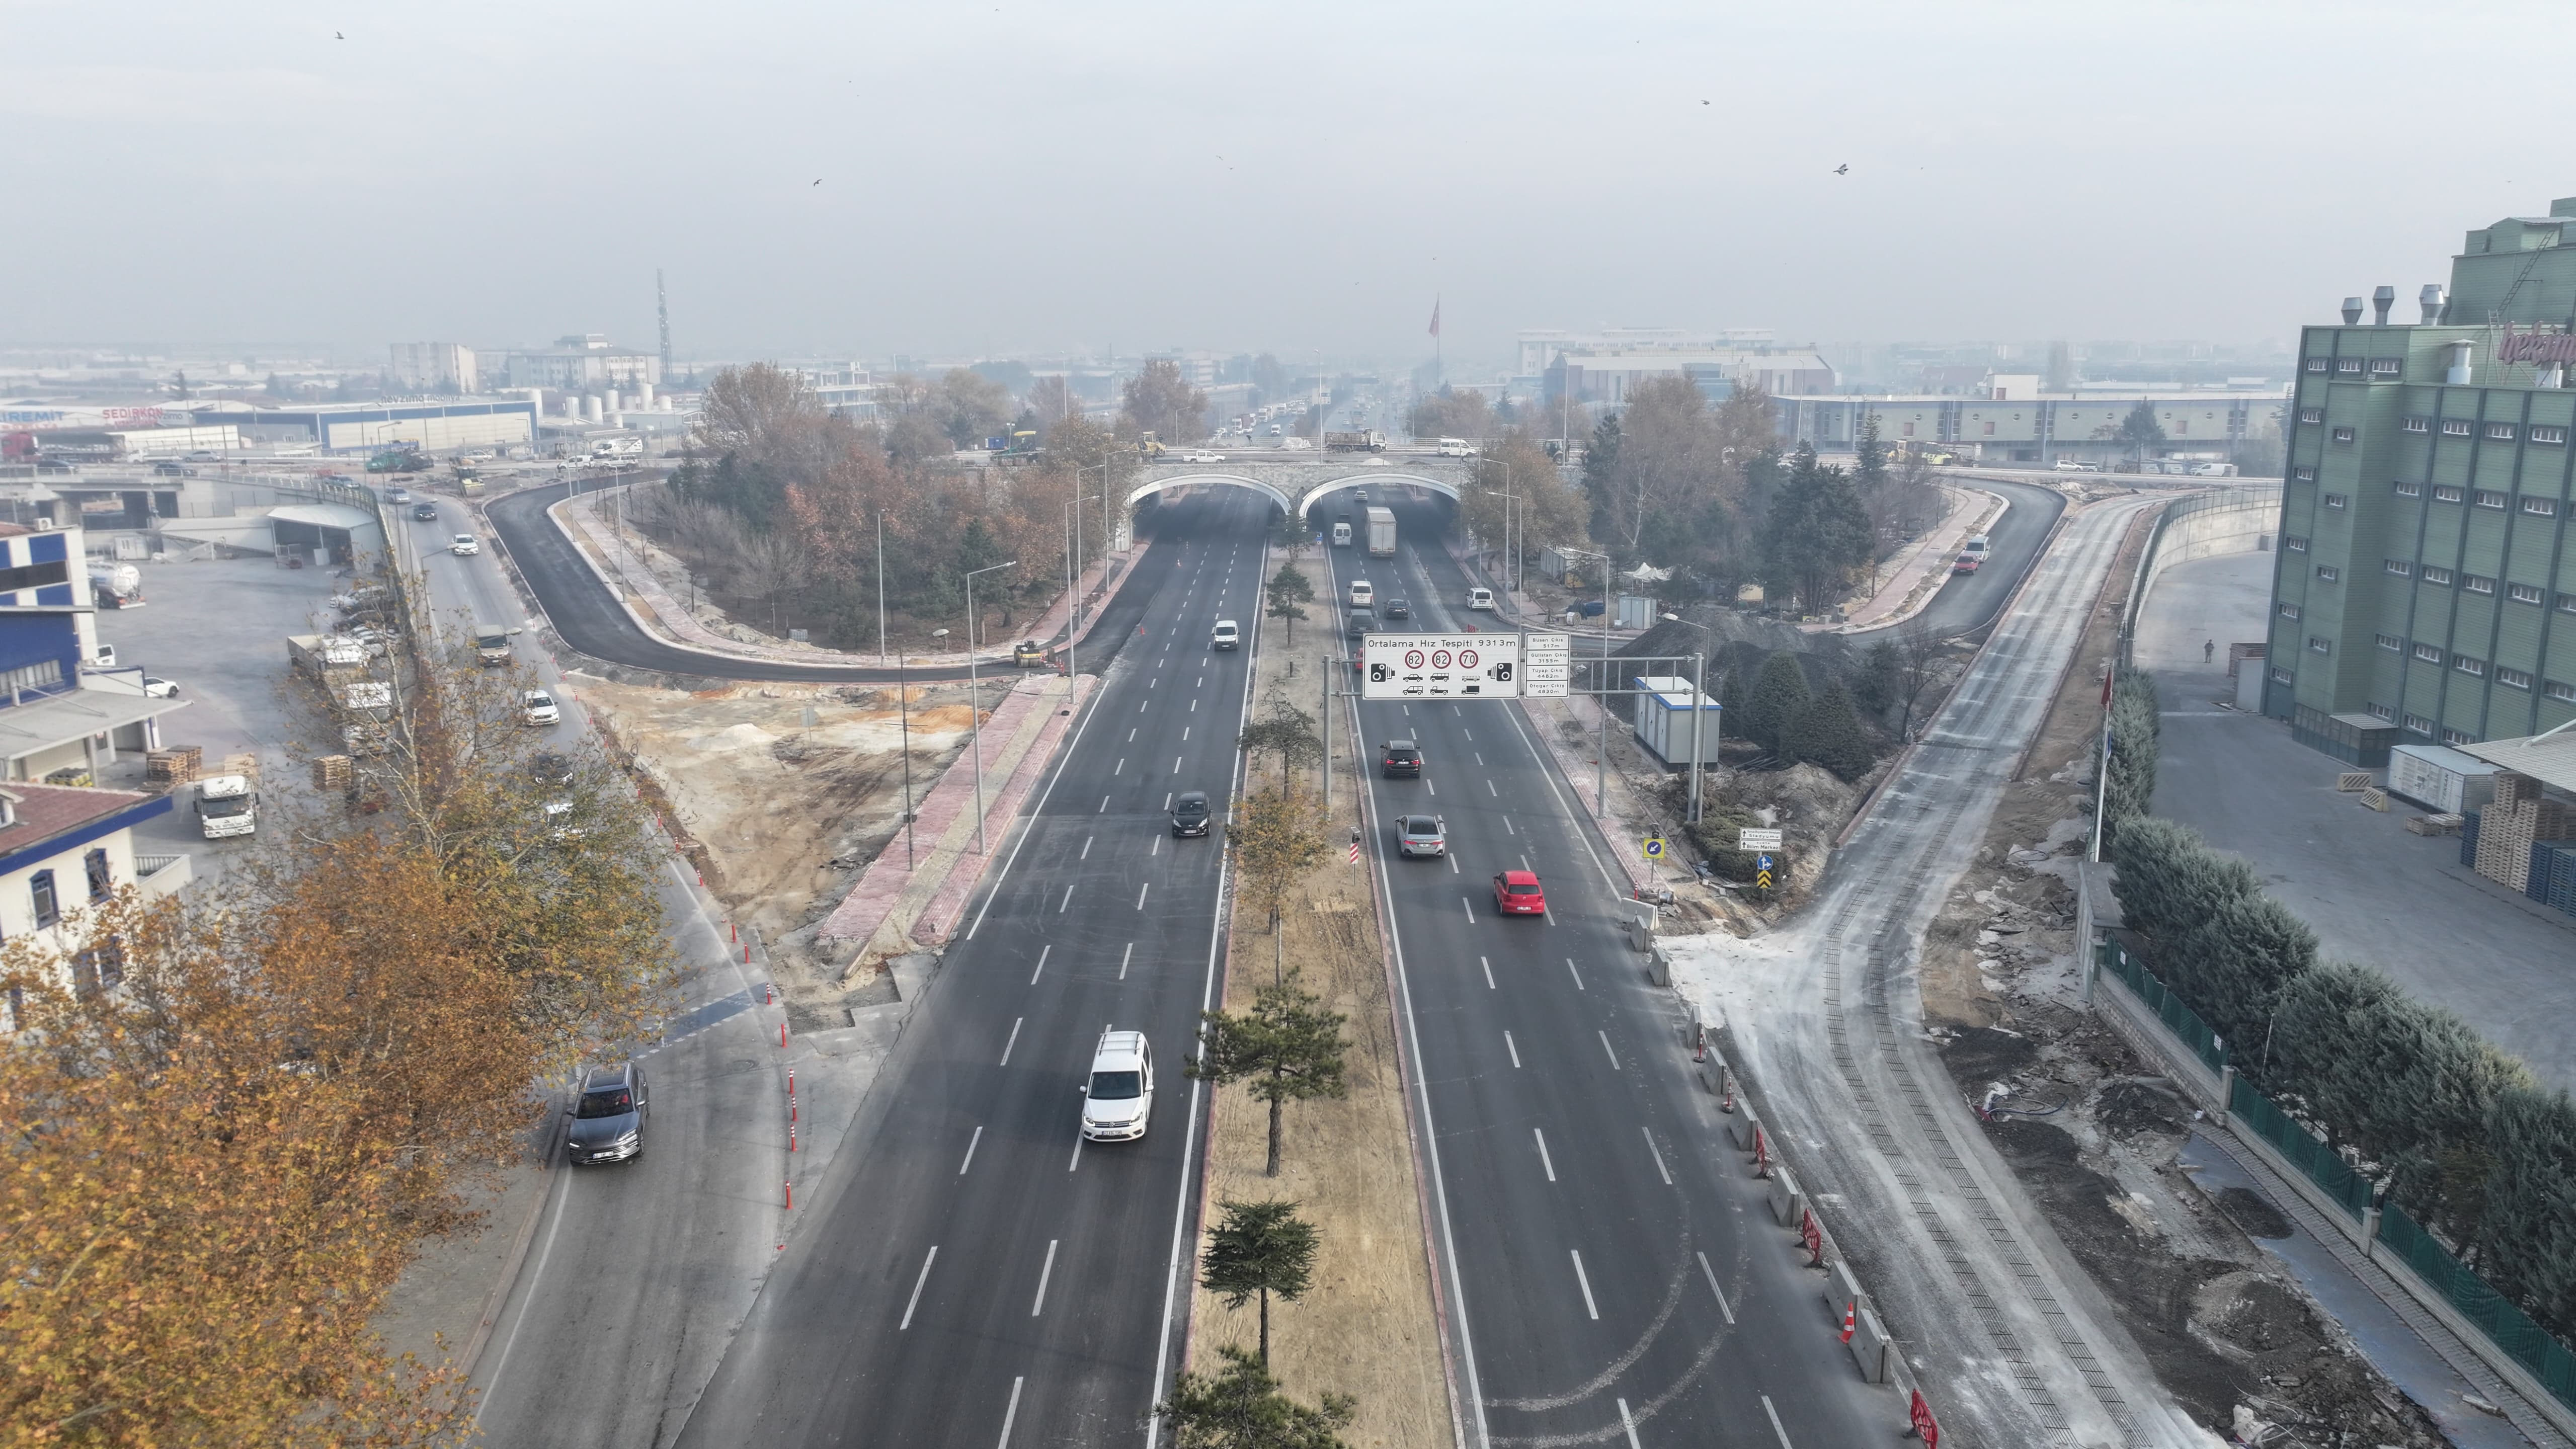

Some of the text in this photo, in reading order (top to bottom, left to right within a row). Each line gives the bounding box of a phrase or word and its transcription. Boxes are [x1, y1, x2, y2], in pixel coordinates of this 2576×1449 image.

[1368, 639, 1413, 648] Ortalama
[1441, 639, 1472, 649] Tespiti
[1408, 655, 1420, 664] 82
[1435, 655, 1447, 664] 82
[1463, 655, 1475, 664] 70
